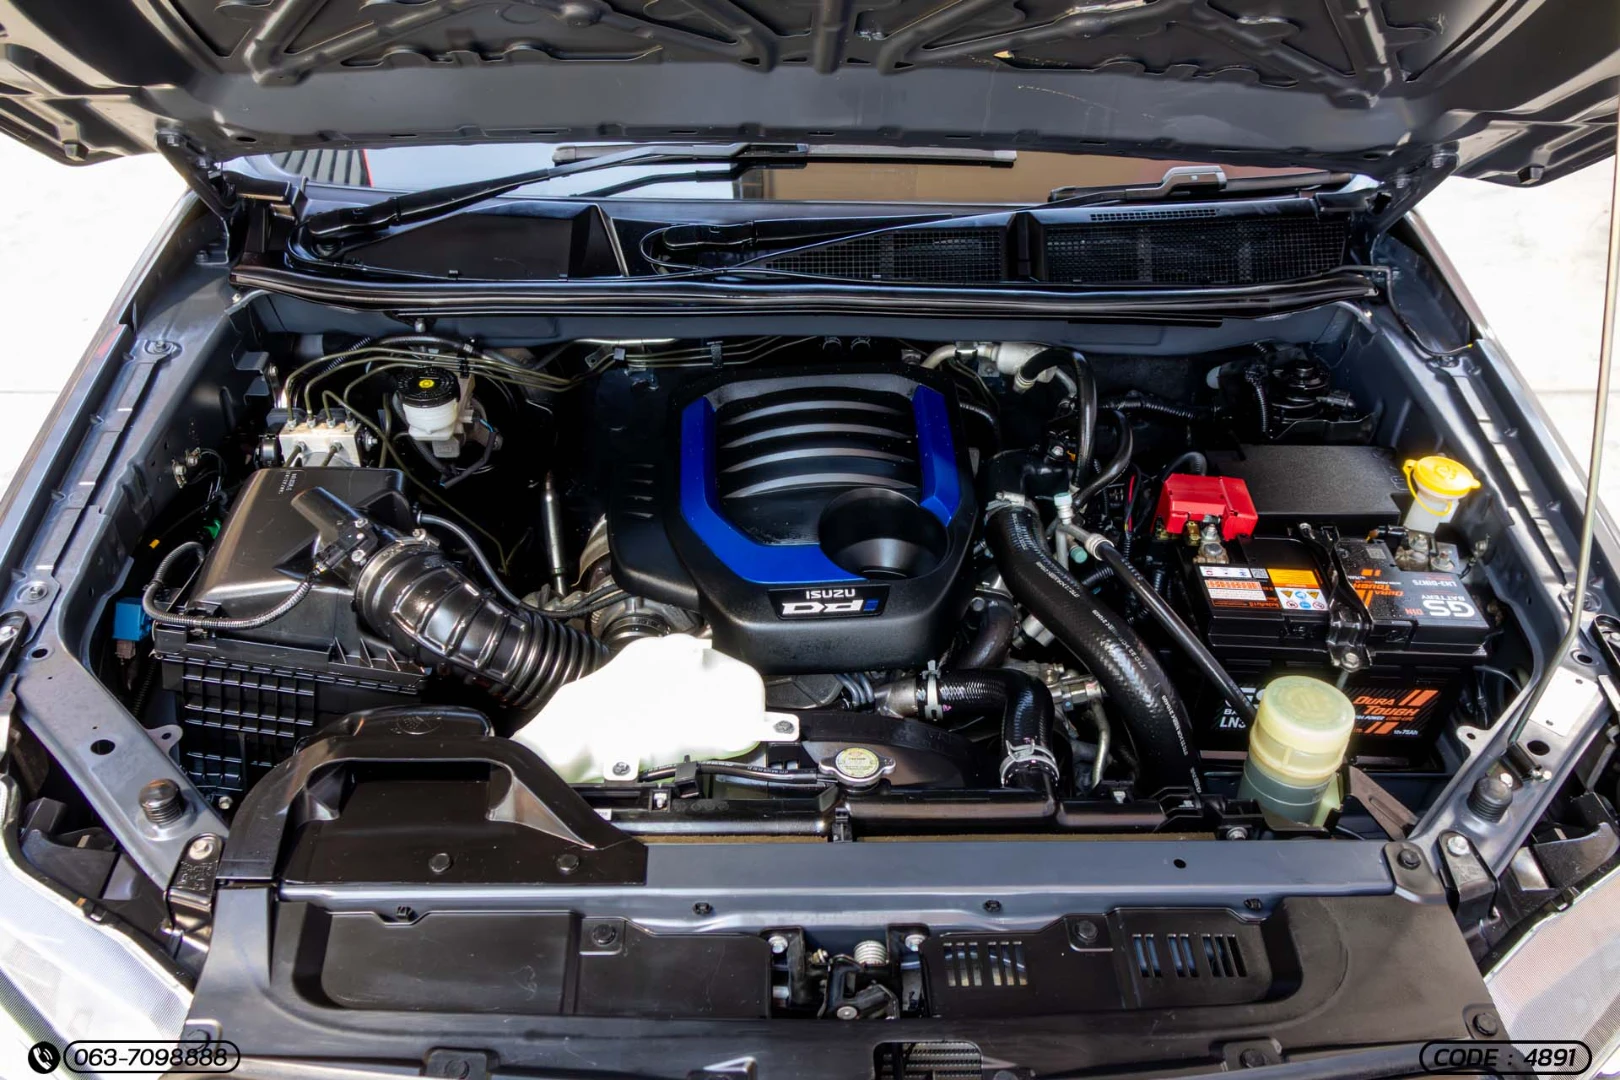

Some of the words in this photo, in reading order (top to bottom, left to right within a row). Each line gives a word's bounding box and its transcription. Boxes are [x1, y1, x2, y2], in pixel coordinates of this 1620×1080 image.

[806, 588, 856, 600] ISUZU
[1374, 589, 1404, 597] DURA
[1421, 593, 1466, 601] BATTERY
[1404, 607, 1425, 616] DIN
[1423, 599, 1475, 618] GS
[1352, 695, 1396, 706] DURA
[1363, 705, 1420, 716] TOUGH
